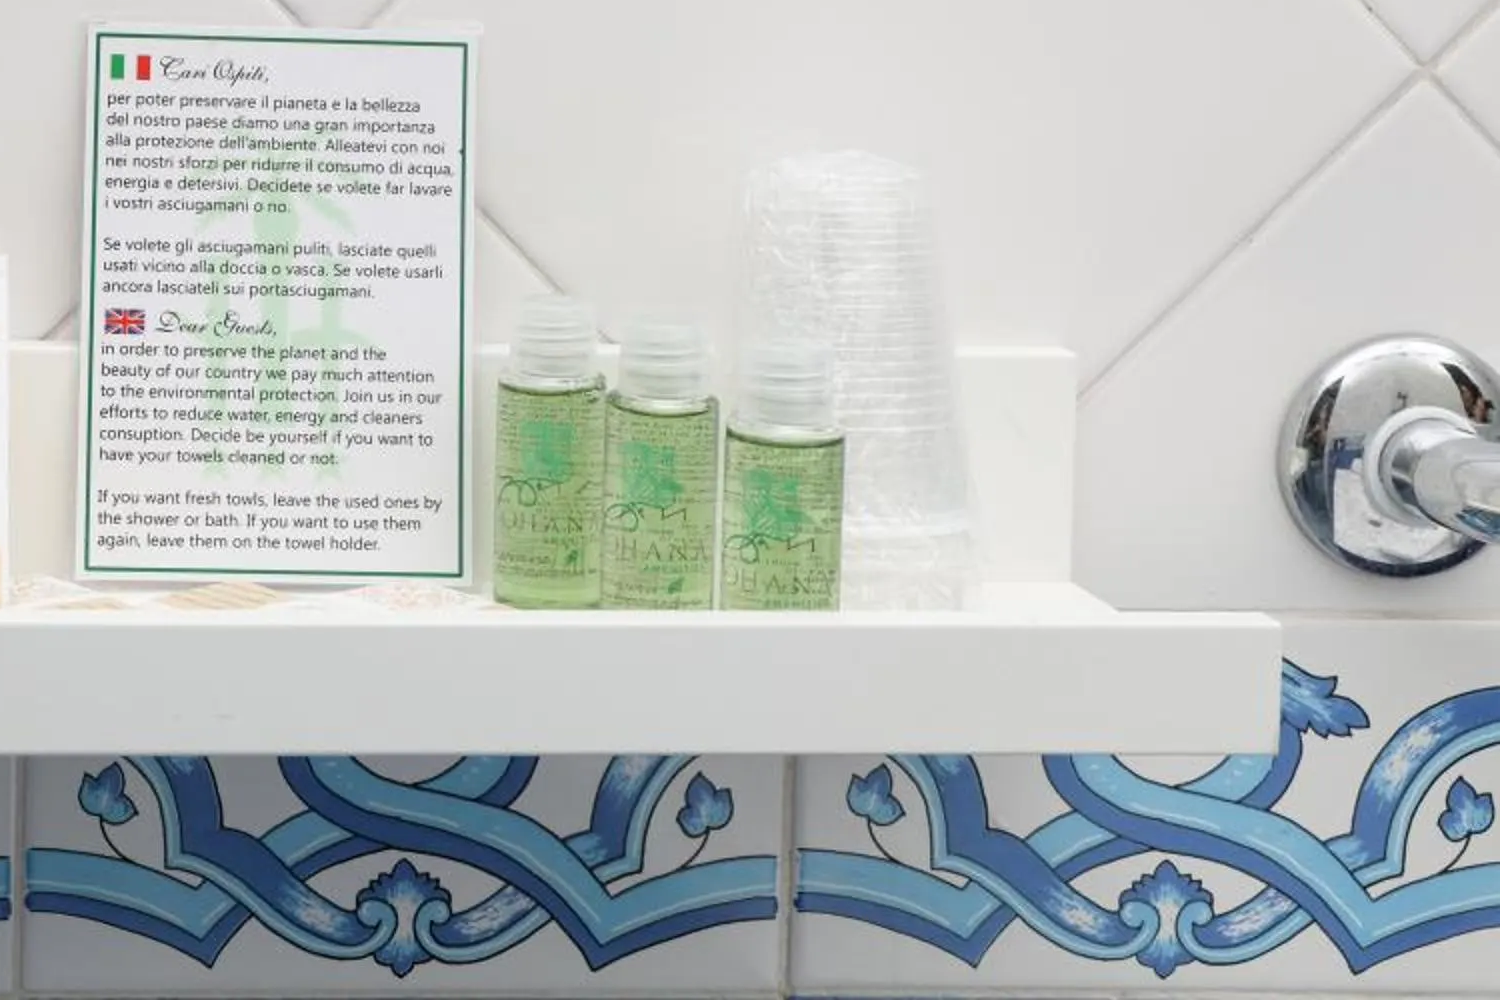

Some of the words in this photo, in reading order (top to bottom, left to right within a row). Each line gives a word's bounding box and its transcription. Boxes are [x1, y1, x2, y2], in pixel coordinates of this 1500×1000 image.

[159, 55, 207, 81] Cari
[213, 59, 270, 87] Ospiti,
[106, 93, 132, 109] per
[134, 91, 176, 110] poter
[178, 95, 257, 111] preservare
[260, 94, 269, 108] il
[272, 94, 327, 113] pianeta
[330, 98, 341, 110] e
[344, 96, 358, 110] la
[360, 96, 421, 112] bellezza
[105, 111, 129, 126] del
[132, 112, 181, 127] nostro
[184, 116, 228, 132] paese
[231, 114, 279, 129] diamo
[282, 118, 310, 130] una
[313, 119, 349, 134] gran
[352, 117, 436, 136] importanza
[104, 132, 131, 147] alla
[134, 132, 215, 152] protezione
[323, 137, 387, 153] Alleatevi
[390, 141, 418, 153] con
[422, 139, 445, 154] noi
[104, 153, 127, 168] nei
[131, 153, 174, 169] nostri
[177, 154, 219, 170] sforzi
[221, 158, 247, 174] per
[250, 156, 301, 171] ridurre
[302, 157, 313, 172] il
[316, 160, 385, 173] consumo
[387, 159, 403, 174] di
[104, 173, 160, 192] energia
[162, 178, 173, 189] e
[176, 175, 243, 191] detersivi.
[246, 177, 313, 193] Decidete
[316, 181, 333, 193] se
[335, 179, 381, 194] volete
[384, 180, 404, 195] far
[408, 180, 452, 196] lavare
[104, 194, 109, 209] i
[112, 194, 153, 210] vostri
[156, 195, 249, 215] asciugamani
[252, 200, 264, 212] o
[102, 236, 121, 251] Se
[124, 236, 171, 252] volete
[174, 238, 193, 256] gli
[196, 238, 289, 258] asciugamani
[337, 241, 393, 257] lasciate
[395, 242, 437, 261] quelli
[102, 257, 138, 272] usati
[140, 257, 186, 273] vicino
[188, 258, 215, 274] alla
[218, 259, 267, 275] doccia
[270, 263, 281, 275] o
[284, 264, 328, 276] vasca.
[332, 262, 351, 277] Se
[354, 262, 401, 278] volete
[403, 263, 443, 279] usarli
[101, 281, 153, 293] ancora
[156, 279, 219, 295] lasciateli
[222, 280, 245, 295] sui
[248, 281, 374, 301] portasciugamani.
[155, 310, 208, 334] Dear
[100, 341, 115, 356] in
[118, 341, 160, 357] order
[162, 342, 179, 357] to
[182, 345, 247, 362] preserve
[250, 344, 276, 359] the
[278, 344, 326, 363] planet
[329, 345, 359, 361] and
[362, 346, 387, 361] the
[100, 361, 151, 380] beauty
[154, 362, 172, 377] of
[174, 366, 201, 378] our
[204, 363, 263, 383] country
[264, 368, 287, 380] we
[290, 368, 317, 384] pay
[320, 366, 363, 381] much
[366, 367, 434, 383] attention
[99, 382, 117, 397] to
[119, 383, 145, 398] the
[147, 383, 255, 400] environmental
[342, 387, 373, 403] Join
[376, 391, 395, 403] us
[398, 389, 413, 403] in
[415, 392, 442, 404] our
[98, 403, 149, 419] efforts
[151, 405, 169, 420] to
[172, 405, 223, 421] reduce
[274, 410, 326, 426] energy
[328, 408, 358, 423] and
[361, 409, 423, 425] cleaners
[190, 426, 242, 442] Decide
[244, 428, 265, 443] be
[268, 428, 328, 447] yourself
[331, 429, 342, 444] if
[344, 433, 373, 448] you
[376, 430, 414, 446] want
[417, 431, 433, 446] to
[98, 445, 135, 461] have
[136, 449, 172, 465] your
[175, 447, 224, 462] towels
[226, 448, 286, 464] cleaned
[288, 452, 306, 464] or
[96, 487, 109, 503] If
[110, 491, 140, 506] you
[142, 488, 180, 504] want
[184, 489, 221, 505] fresh
[272, 491, 312, 506] leave
[314, 492, 341, 507] the
[343, 492, 379, 508] used
[382, 496, 420, 509] ones
[422, 494, 442, 512] by
[96, 509, 122, 524] the
[125, 510, 180, 525] shower
[182, 514, 200, 526] or
[245, 512, 257, 527] If
[258, 515, 289, 531] you
[291, 513, 329, 528] want
[332, 514, 349, 529] to
[352, 517, 379, 529] use
[382, 515, 421, 530] them
[146, 531, 185, 547] leave
[188, 532, 228, 547] them
[231, 536, 252, 548] on
[255, 533, 281, 548] the
[284, 534, 325, 549] towel
[328, 534, 380, 550] holder.
